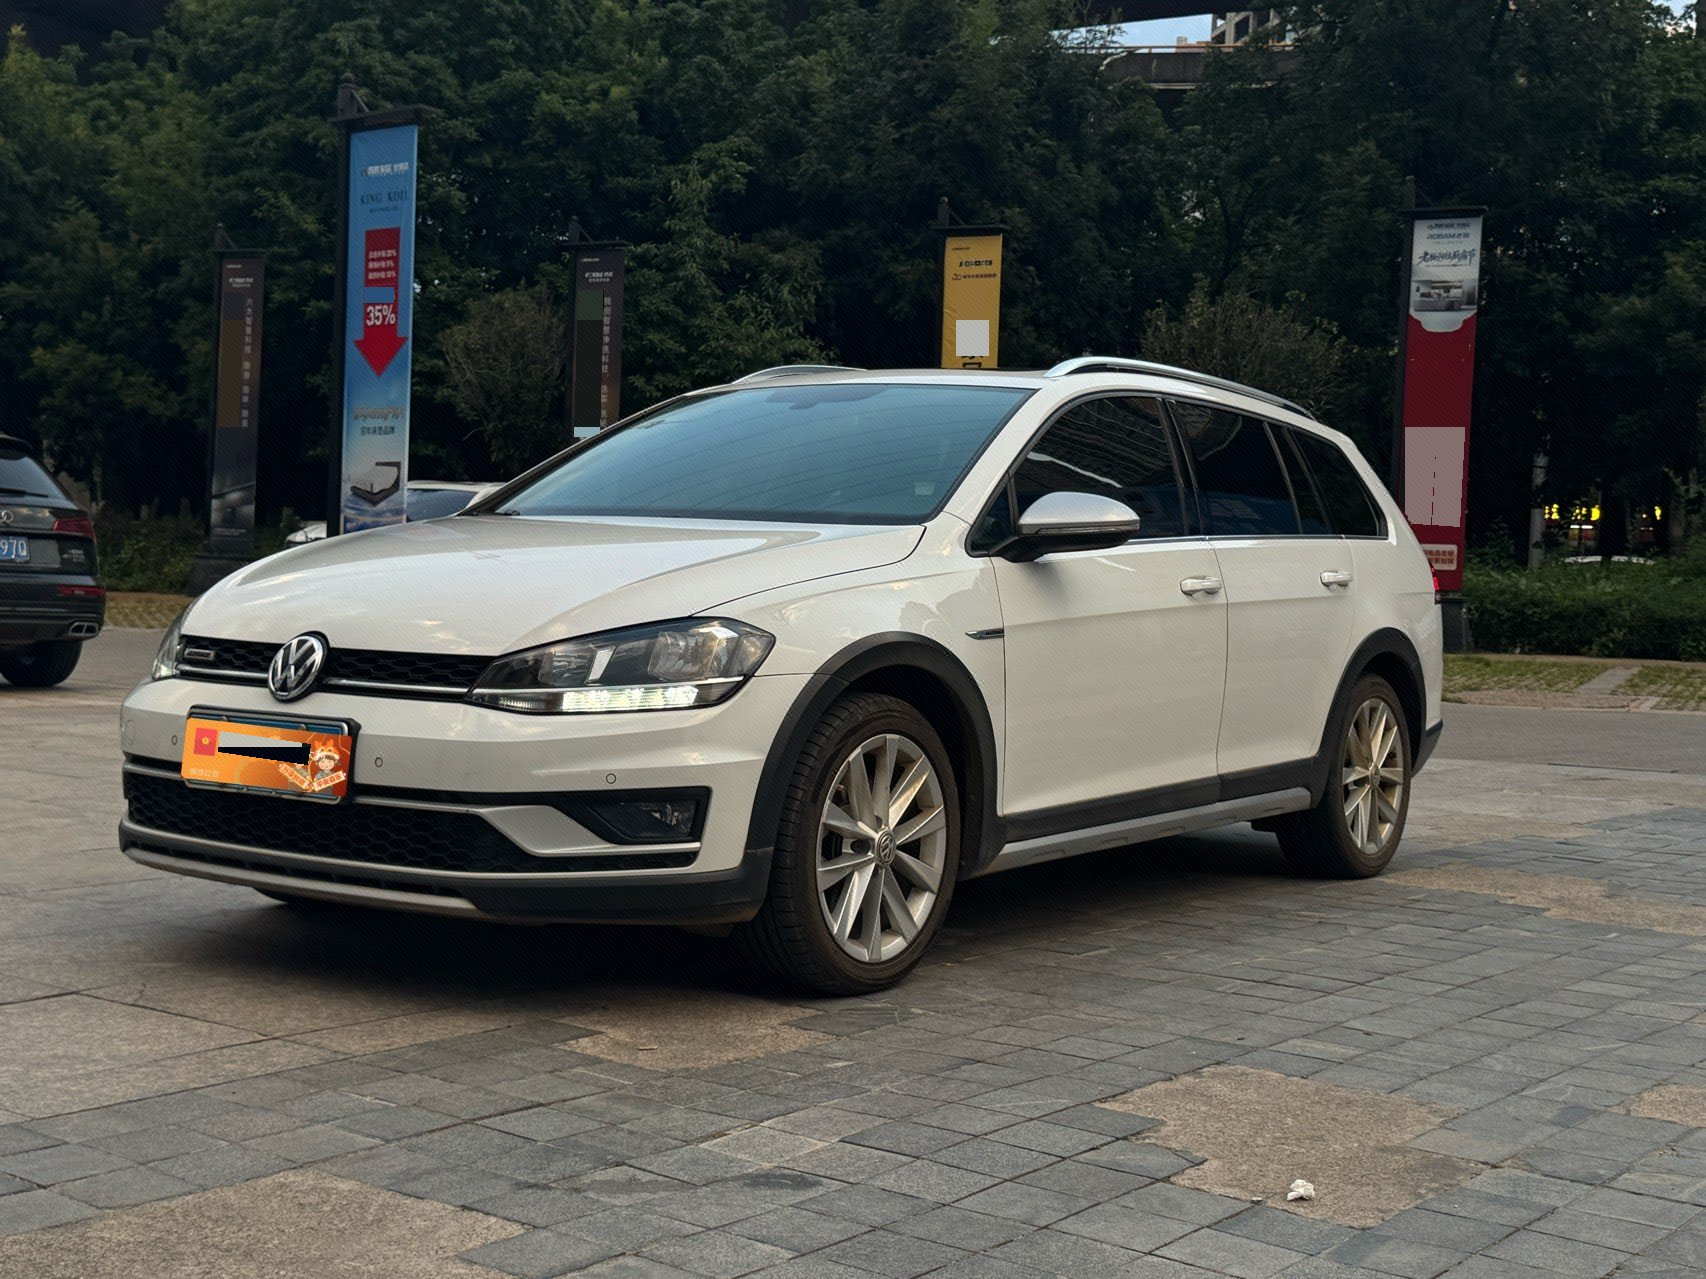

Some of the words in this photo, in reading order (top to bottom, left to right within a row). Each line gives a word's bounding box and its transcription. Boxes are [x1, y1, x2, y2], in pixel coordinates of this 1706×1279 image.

[360, 192, 382, 205] KING
[388, 190, 410, 202] KOIL
[366, 304, 396, 326] 35%
